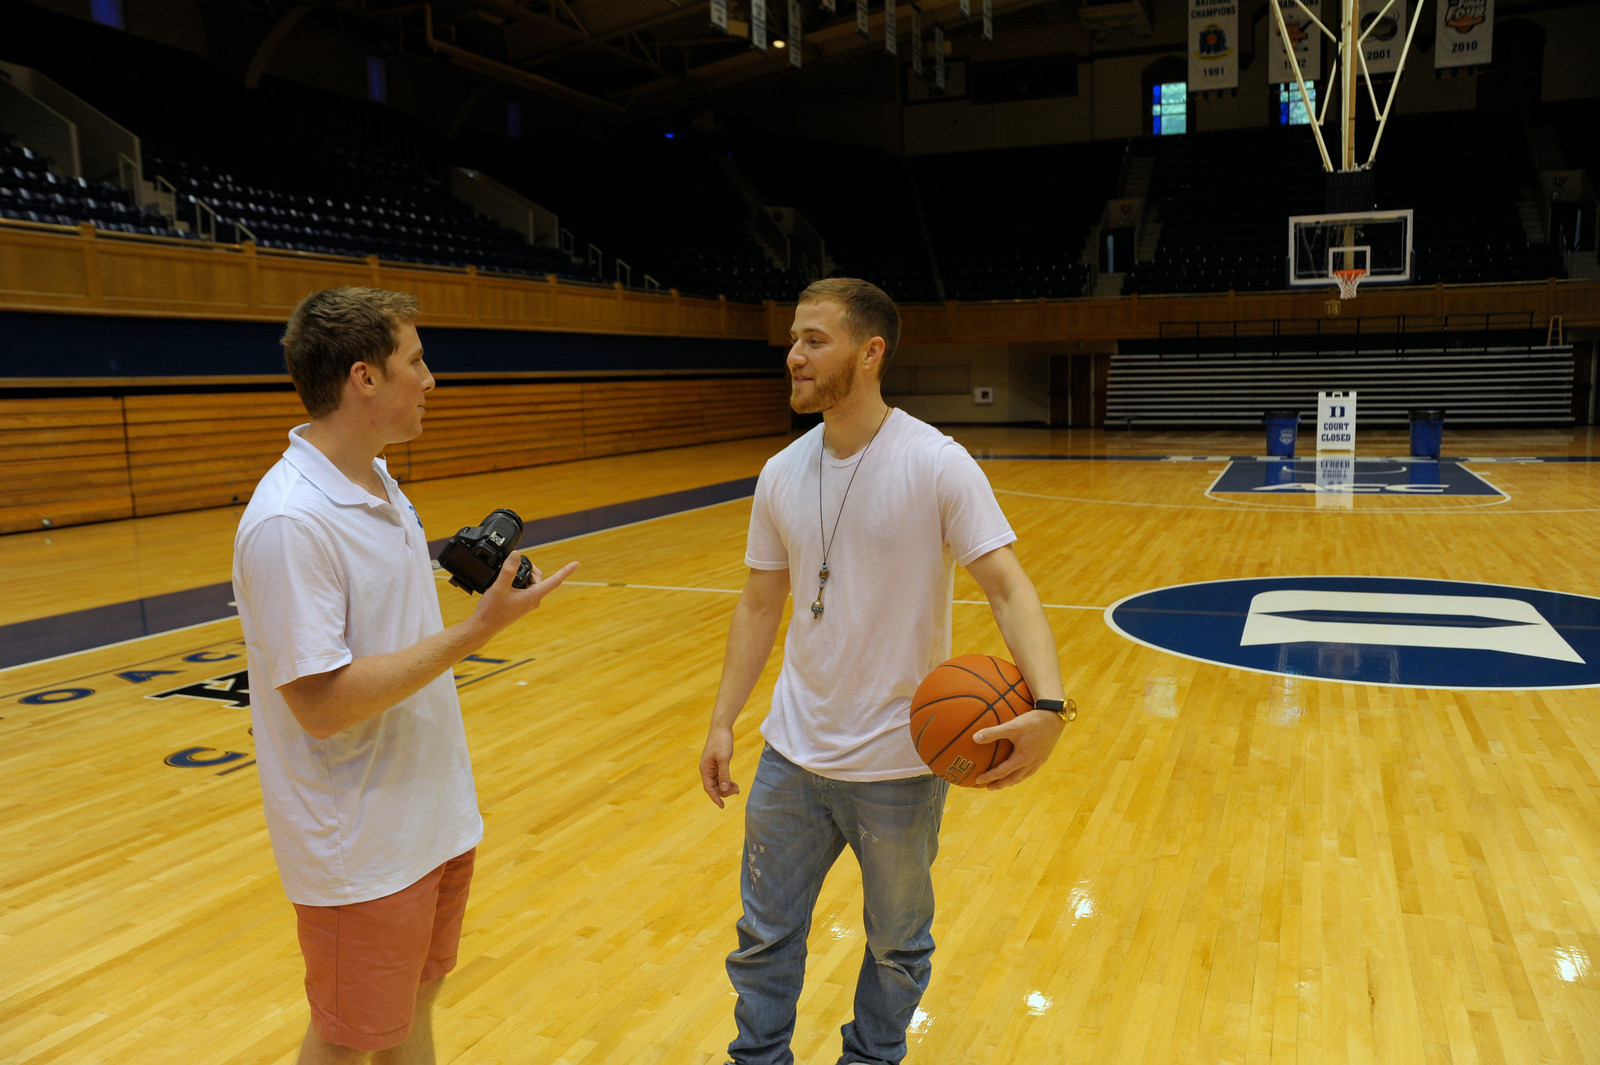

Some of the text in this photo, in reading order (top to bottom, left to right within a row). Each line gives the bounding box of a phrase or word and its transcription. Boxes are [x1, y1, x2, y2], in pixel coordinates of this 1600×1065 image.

[1191, 5, 1236, 19] CHAMPIONS
[1452, 41, 1478, 52] 2010
[1367, 49, 1391, 60] 2001
[1284, 59, 1306, 69] 12
[1203, 67, 1225, 77] 1991
[1323, 422, 1350, 431] COURT
[1321, 433, 1351, 442] CLOSED
[1252, 482, 1450, 494] ACC
